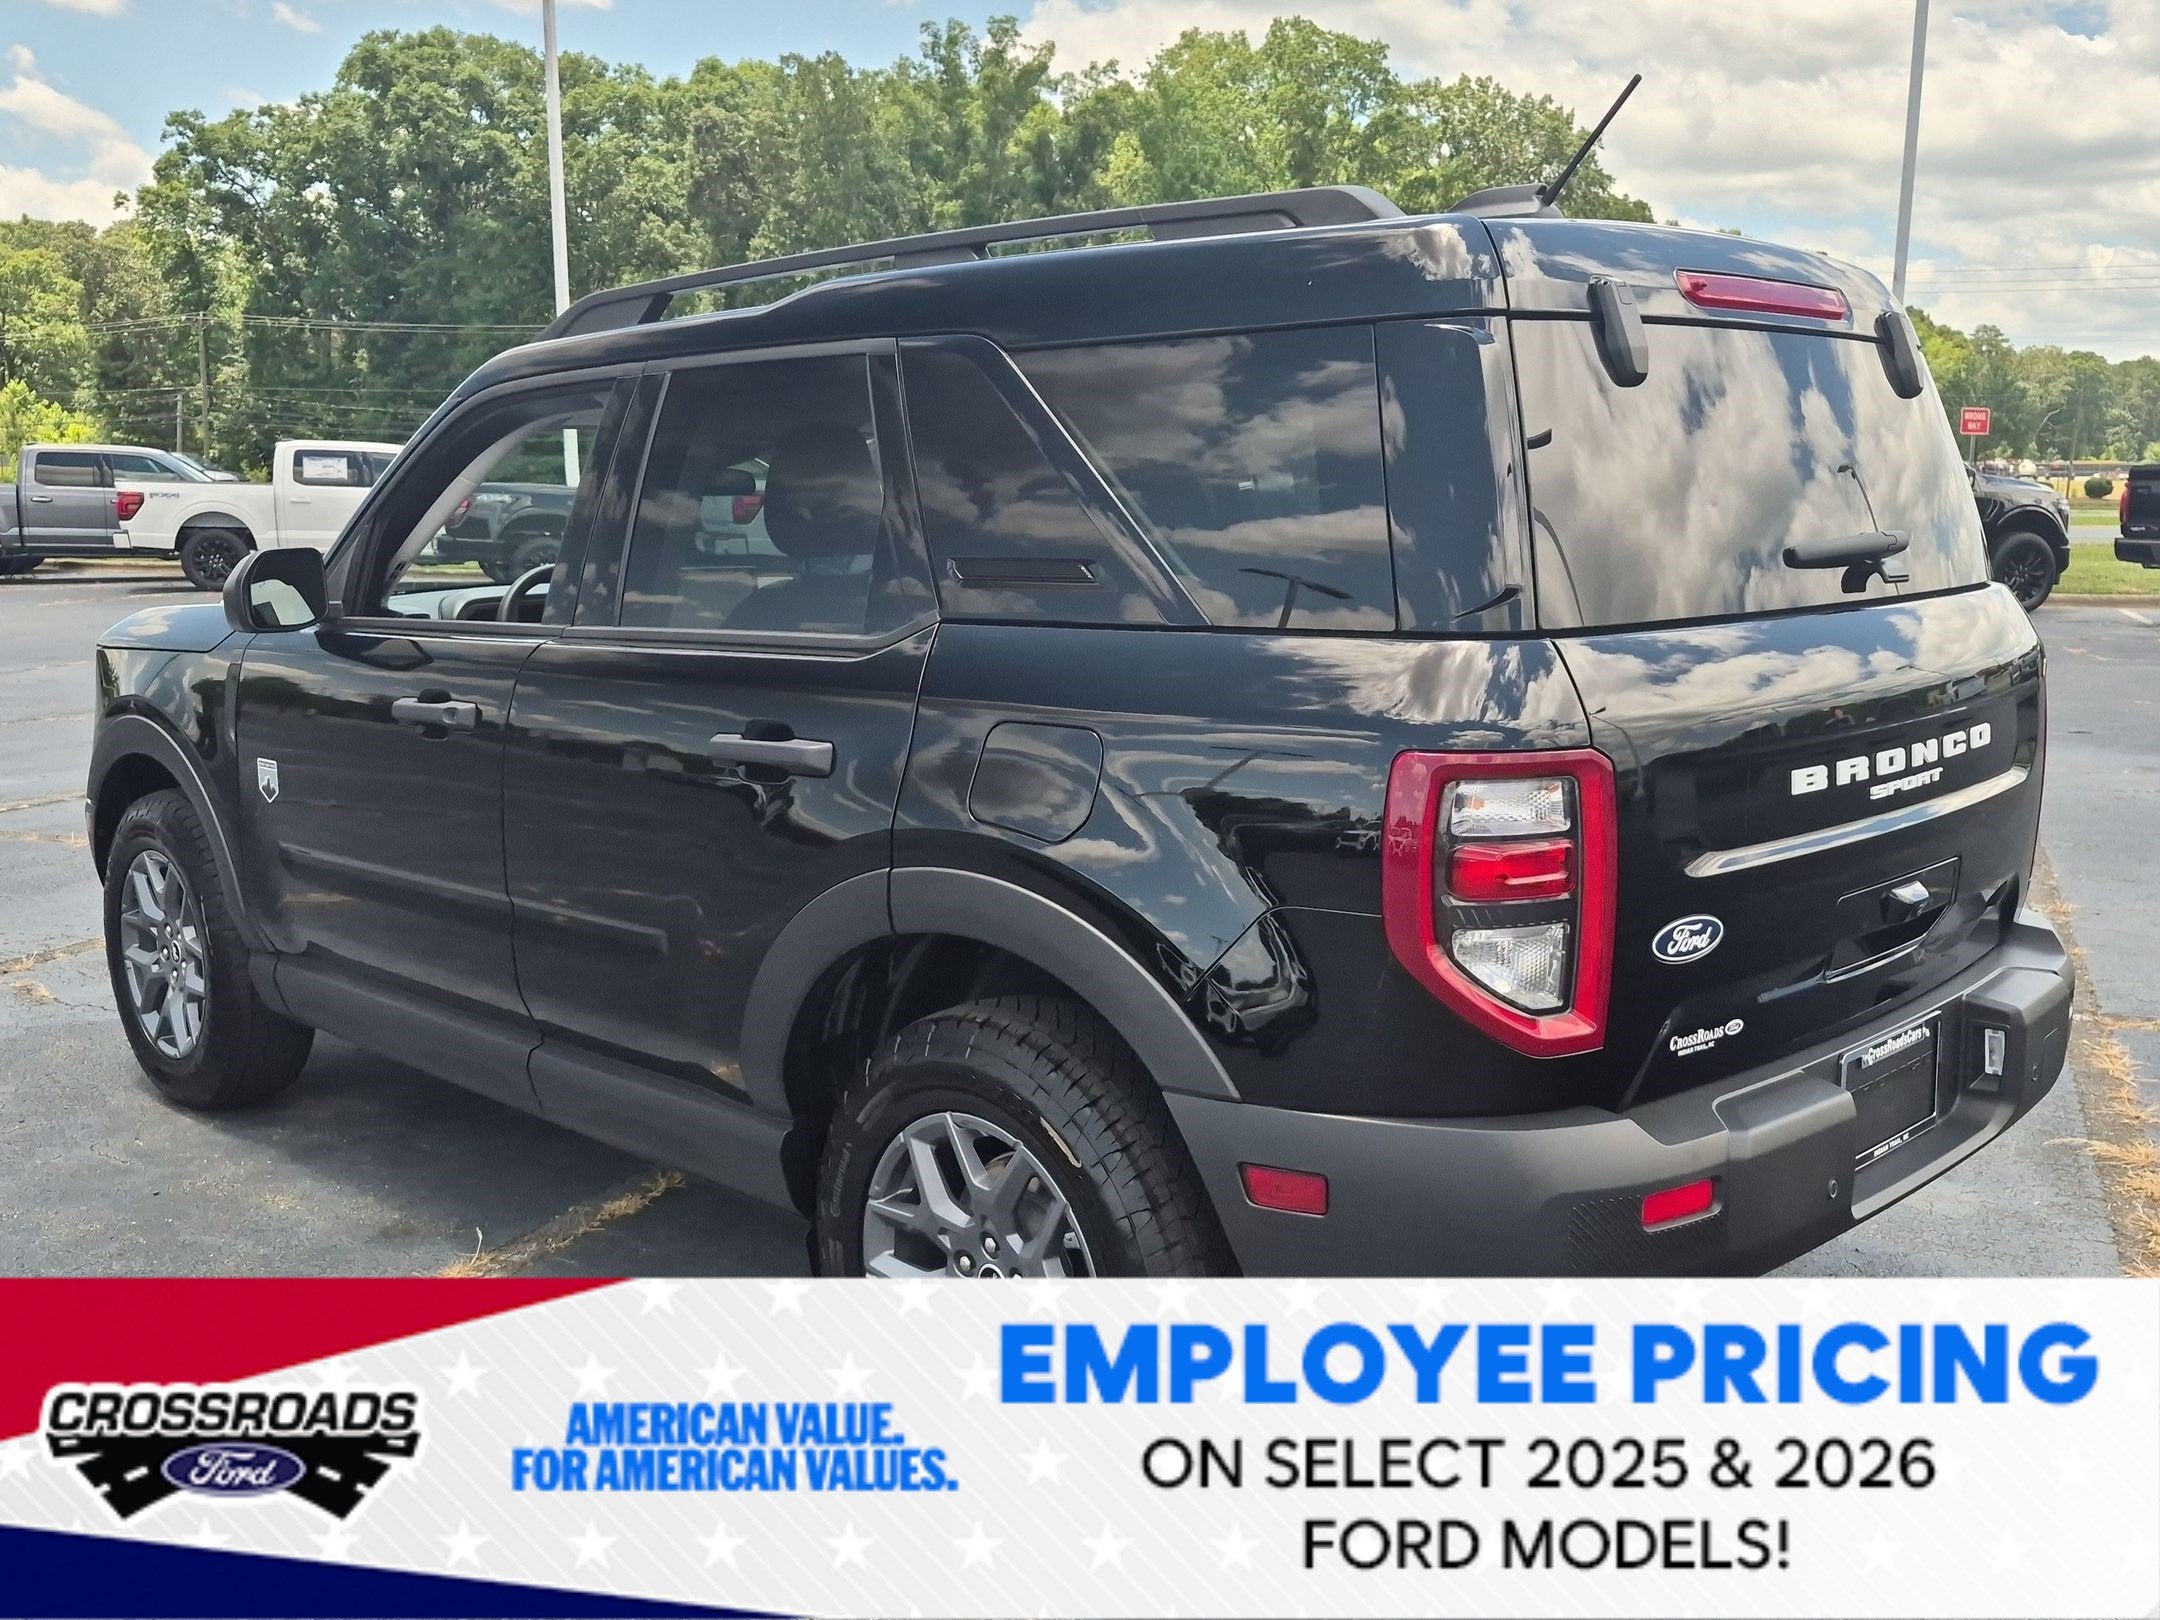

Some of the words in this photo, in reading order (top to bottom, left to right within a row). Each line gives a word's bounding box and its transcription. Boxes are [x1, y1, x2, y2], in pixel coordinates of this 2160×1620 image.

[1964, 411, 1987, 421] WRONG
[1967, 421, 1981, 430] WAY
[1790, 722, 1991, 796] BRONCO
[1869, 767, 1943, 800] SPORT
[1666, 922, 1713, 955] Ford
